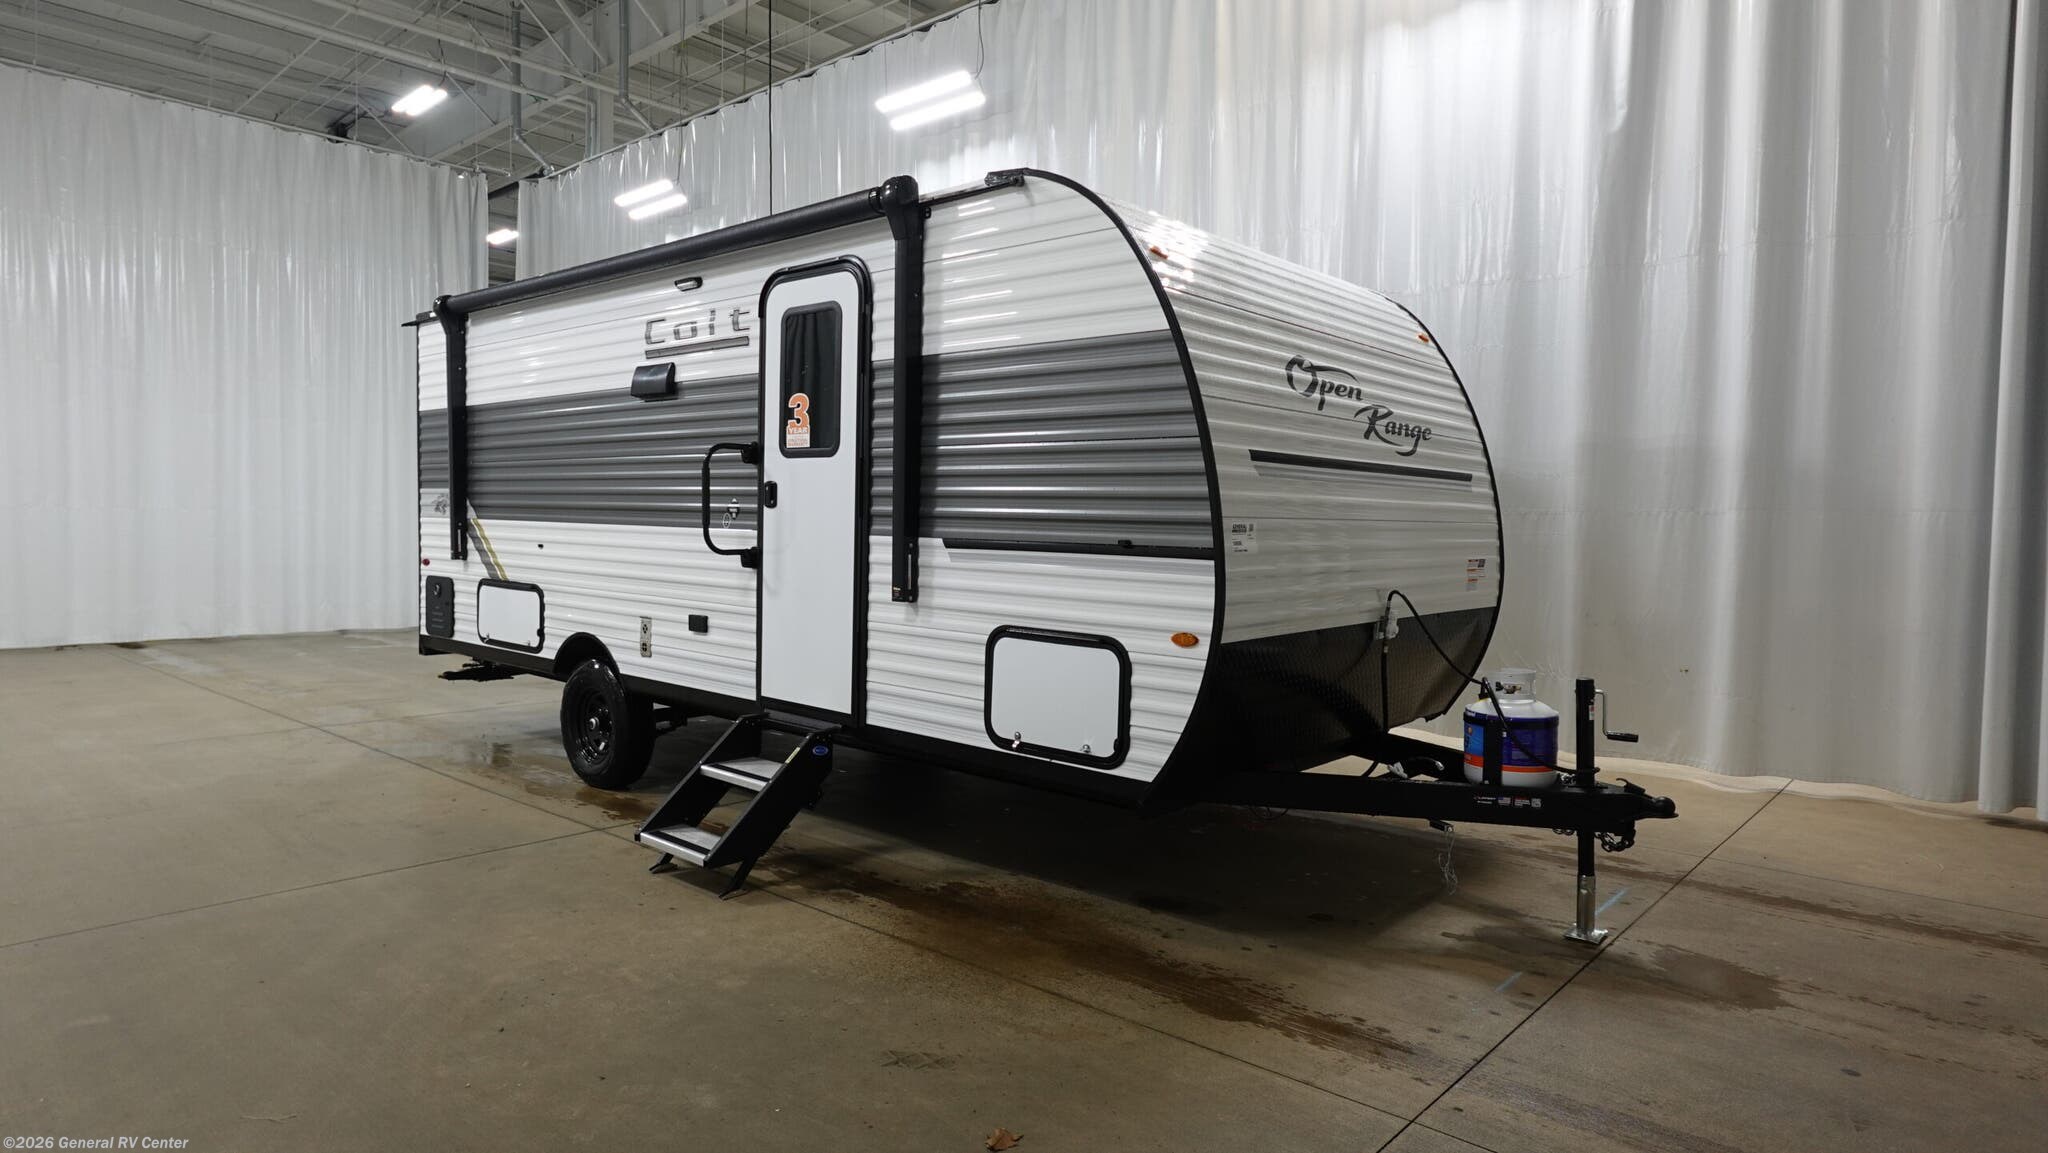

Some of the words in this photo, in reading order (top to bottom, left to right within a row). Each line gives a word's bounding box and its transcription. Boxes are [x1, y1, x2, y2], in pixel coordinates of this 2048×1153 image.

[645, 308, 750, 345] Colt
[1285, 354, 1363, 411] Open
[788, 392, 810, 428] 3
[1354, 403, 1432, 457] Range
